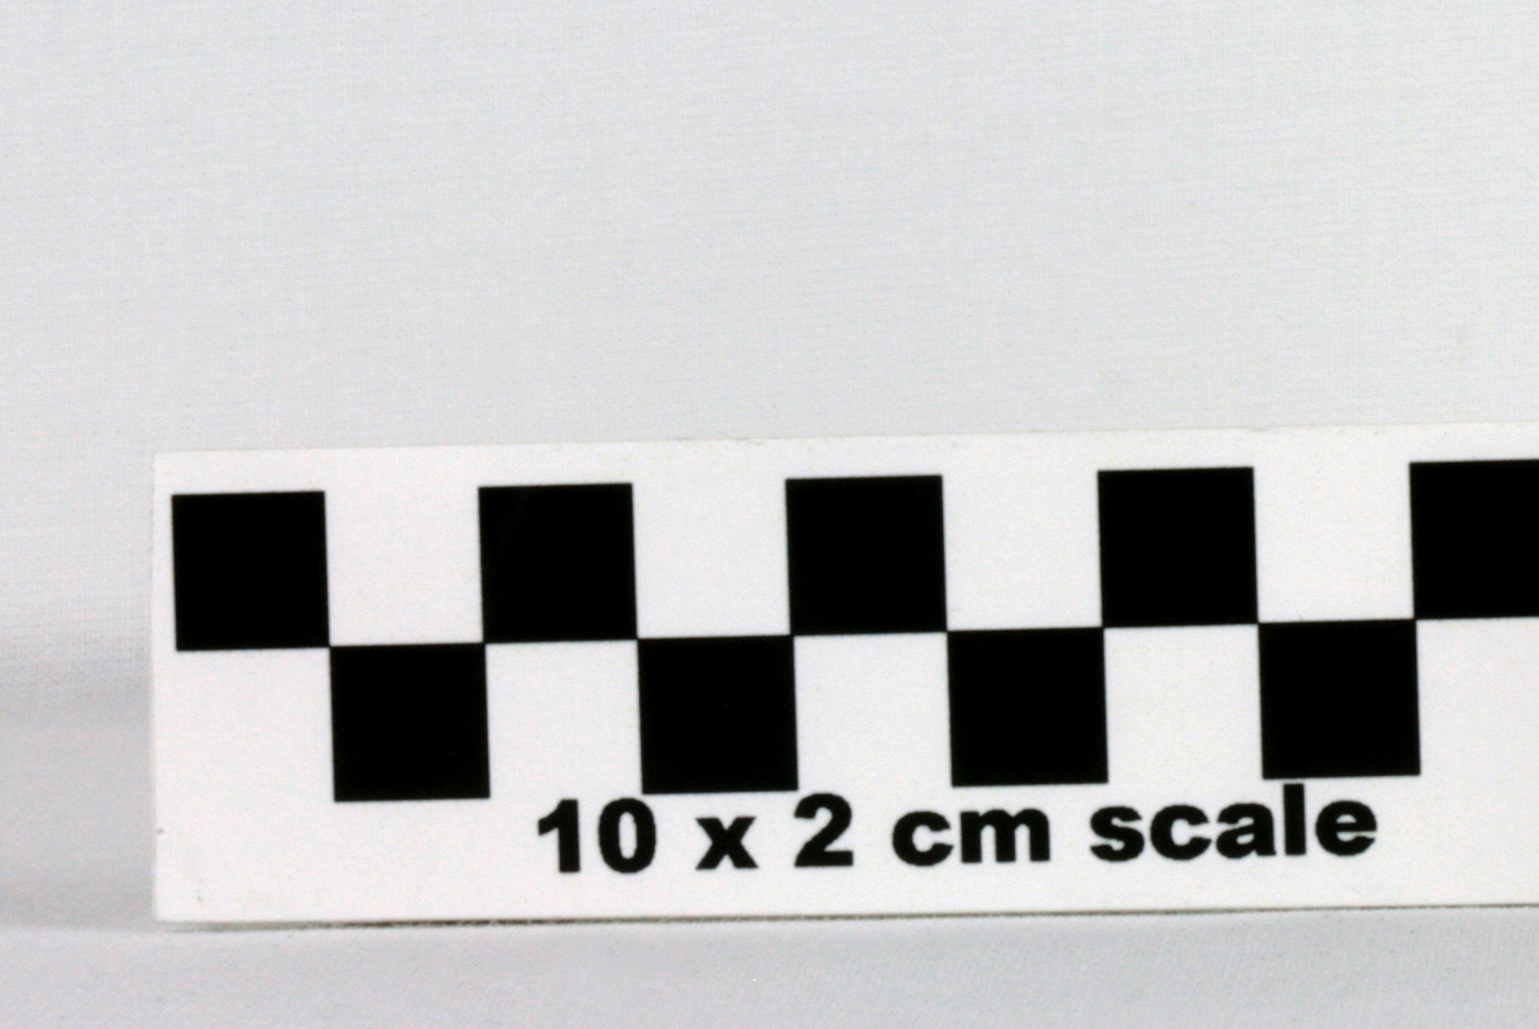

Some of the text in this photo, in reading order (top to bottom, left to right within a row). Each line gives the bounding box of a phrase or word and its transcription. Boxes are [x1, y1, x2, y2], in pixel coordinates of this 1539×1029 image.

[537, 783, 1378, 874] 10 x 2 cm scale
